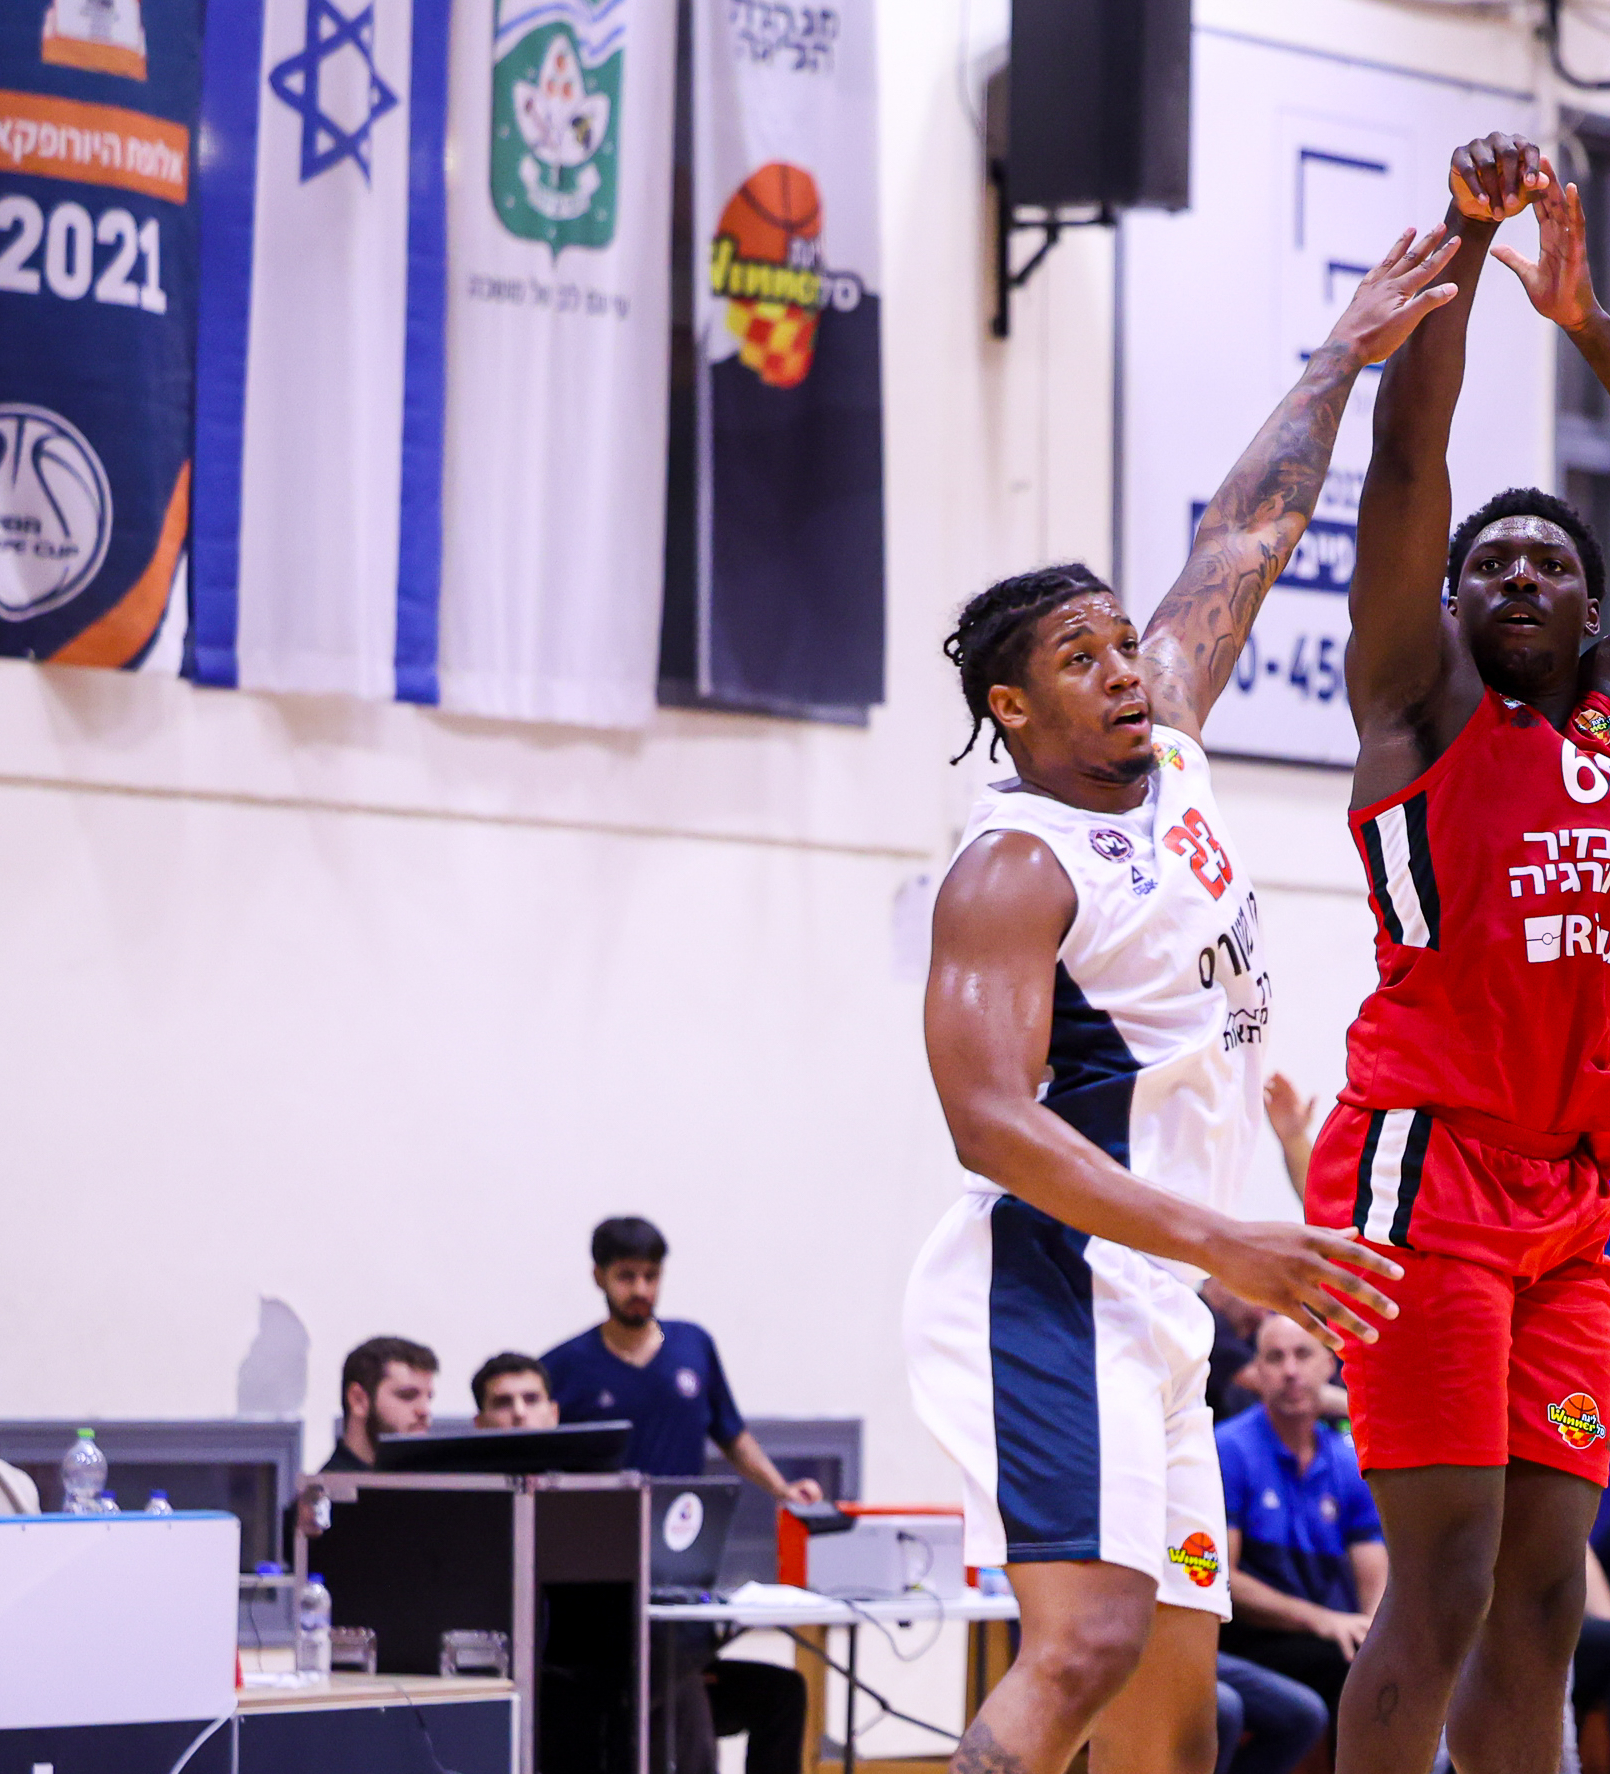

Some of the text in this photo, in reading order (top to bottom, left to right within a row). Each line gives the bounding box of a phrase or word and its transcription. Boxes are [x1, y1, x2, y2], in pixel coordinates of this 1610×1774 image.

[0, 194, 167, 315] 2021
[1162, 807, 1233, 901] 23
[1550, 1406, 1597, 1432] Winner
